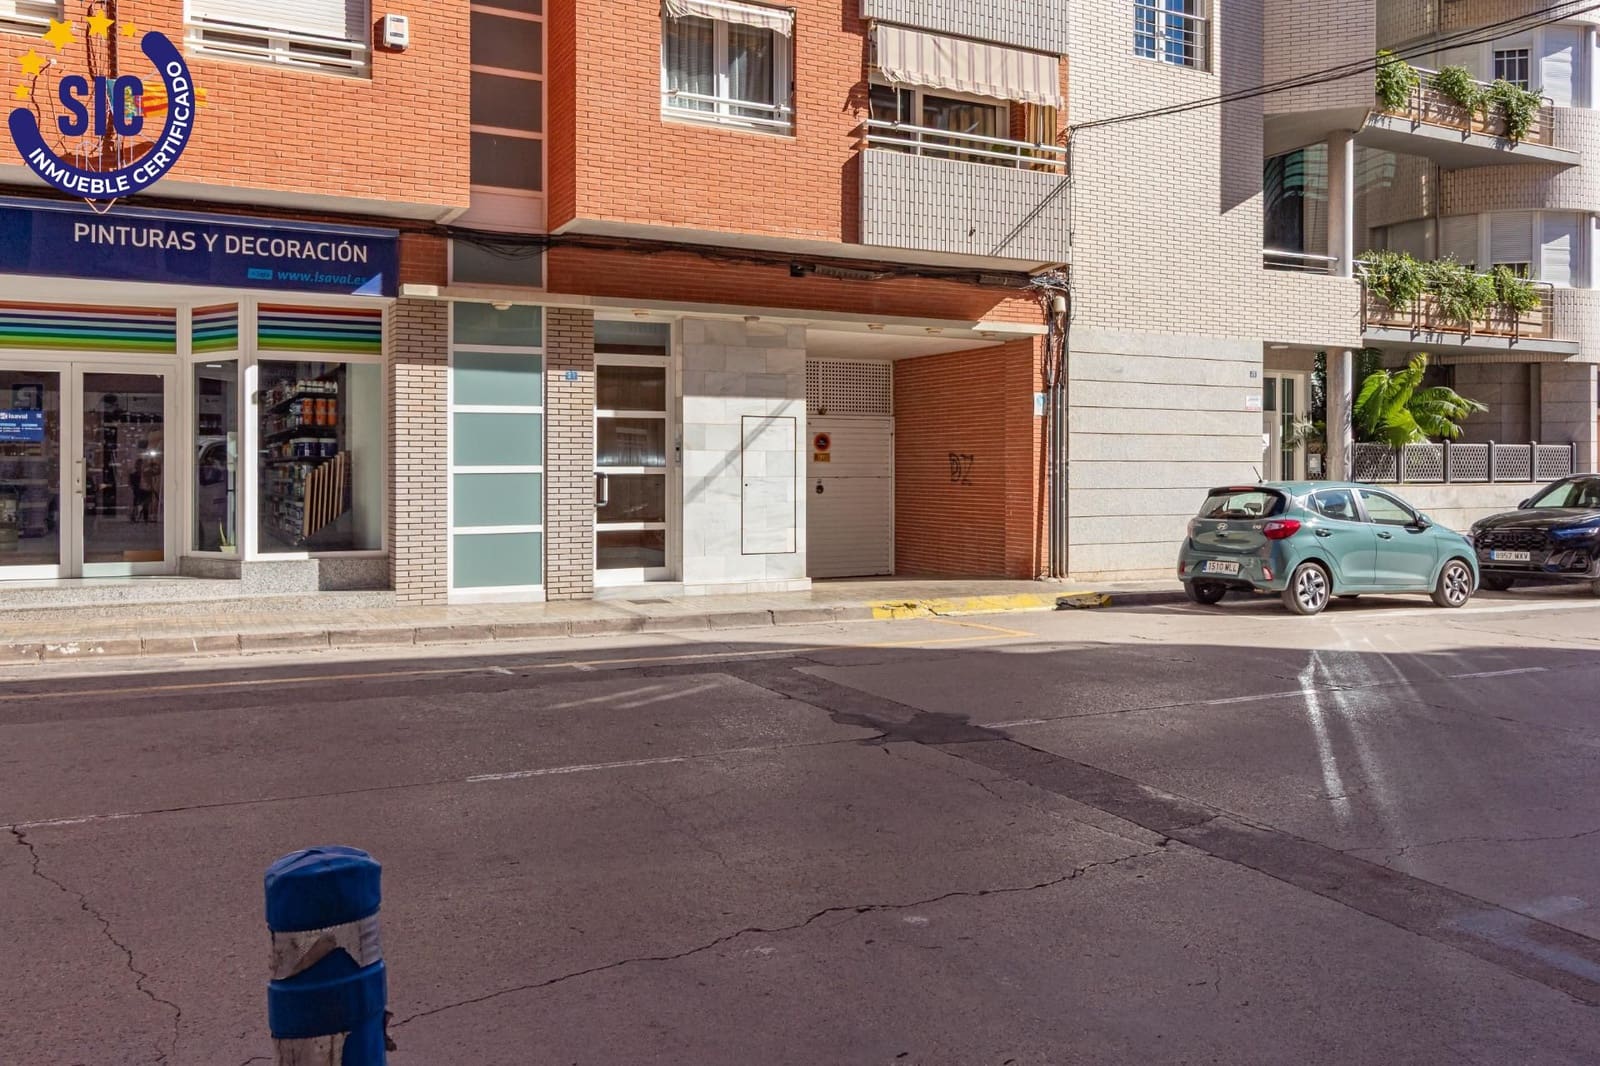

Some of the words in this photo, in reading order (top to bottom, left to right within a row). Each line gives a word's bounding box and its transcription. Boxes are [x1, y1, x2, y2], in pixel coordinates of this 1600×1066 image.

[73, 222, 195, 252] PINTURAS
[203, 233, 219, 253] Y
[225, 234, 368, 264] DECORACIÓN
